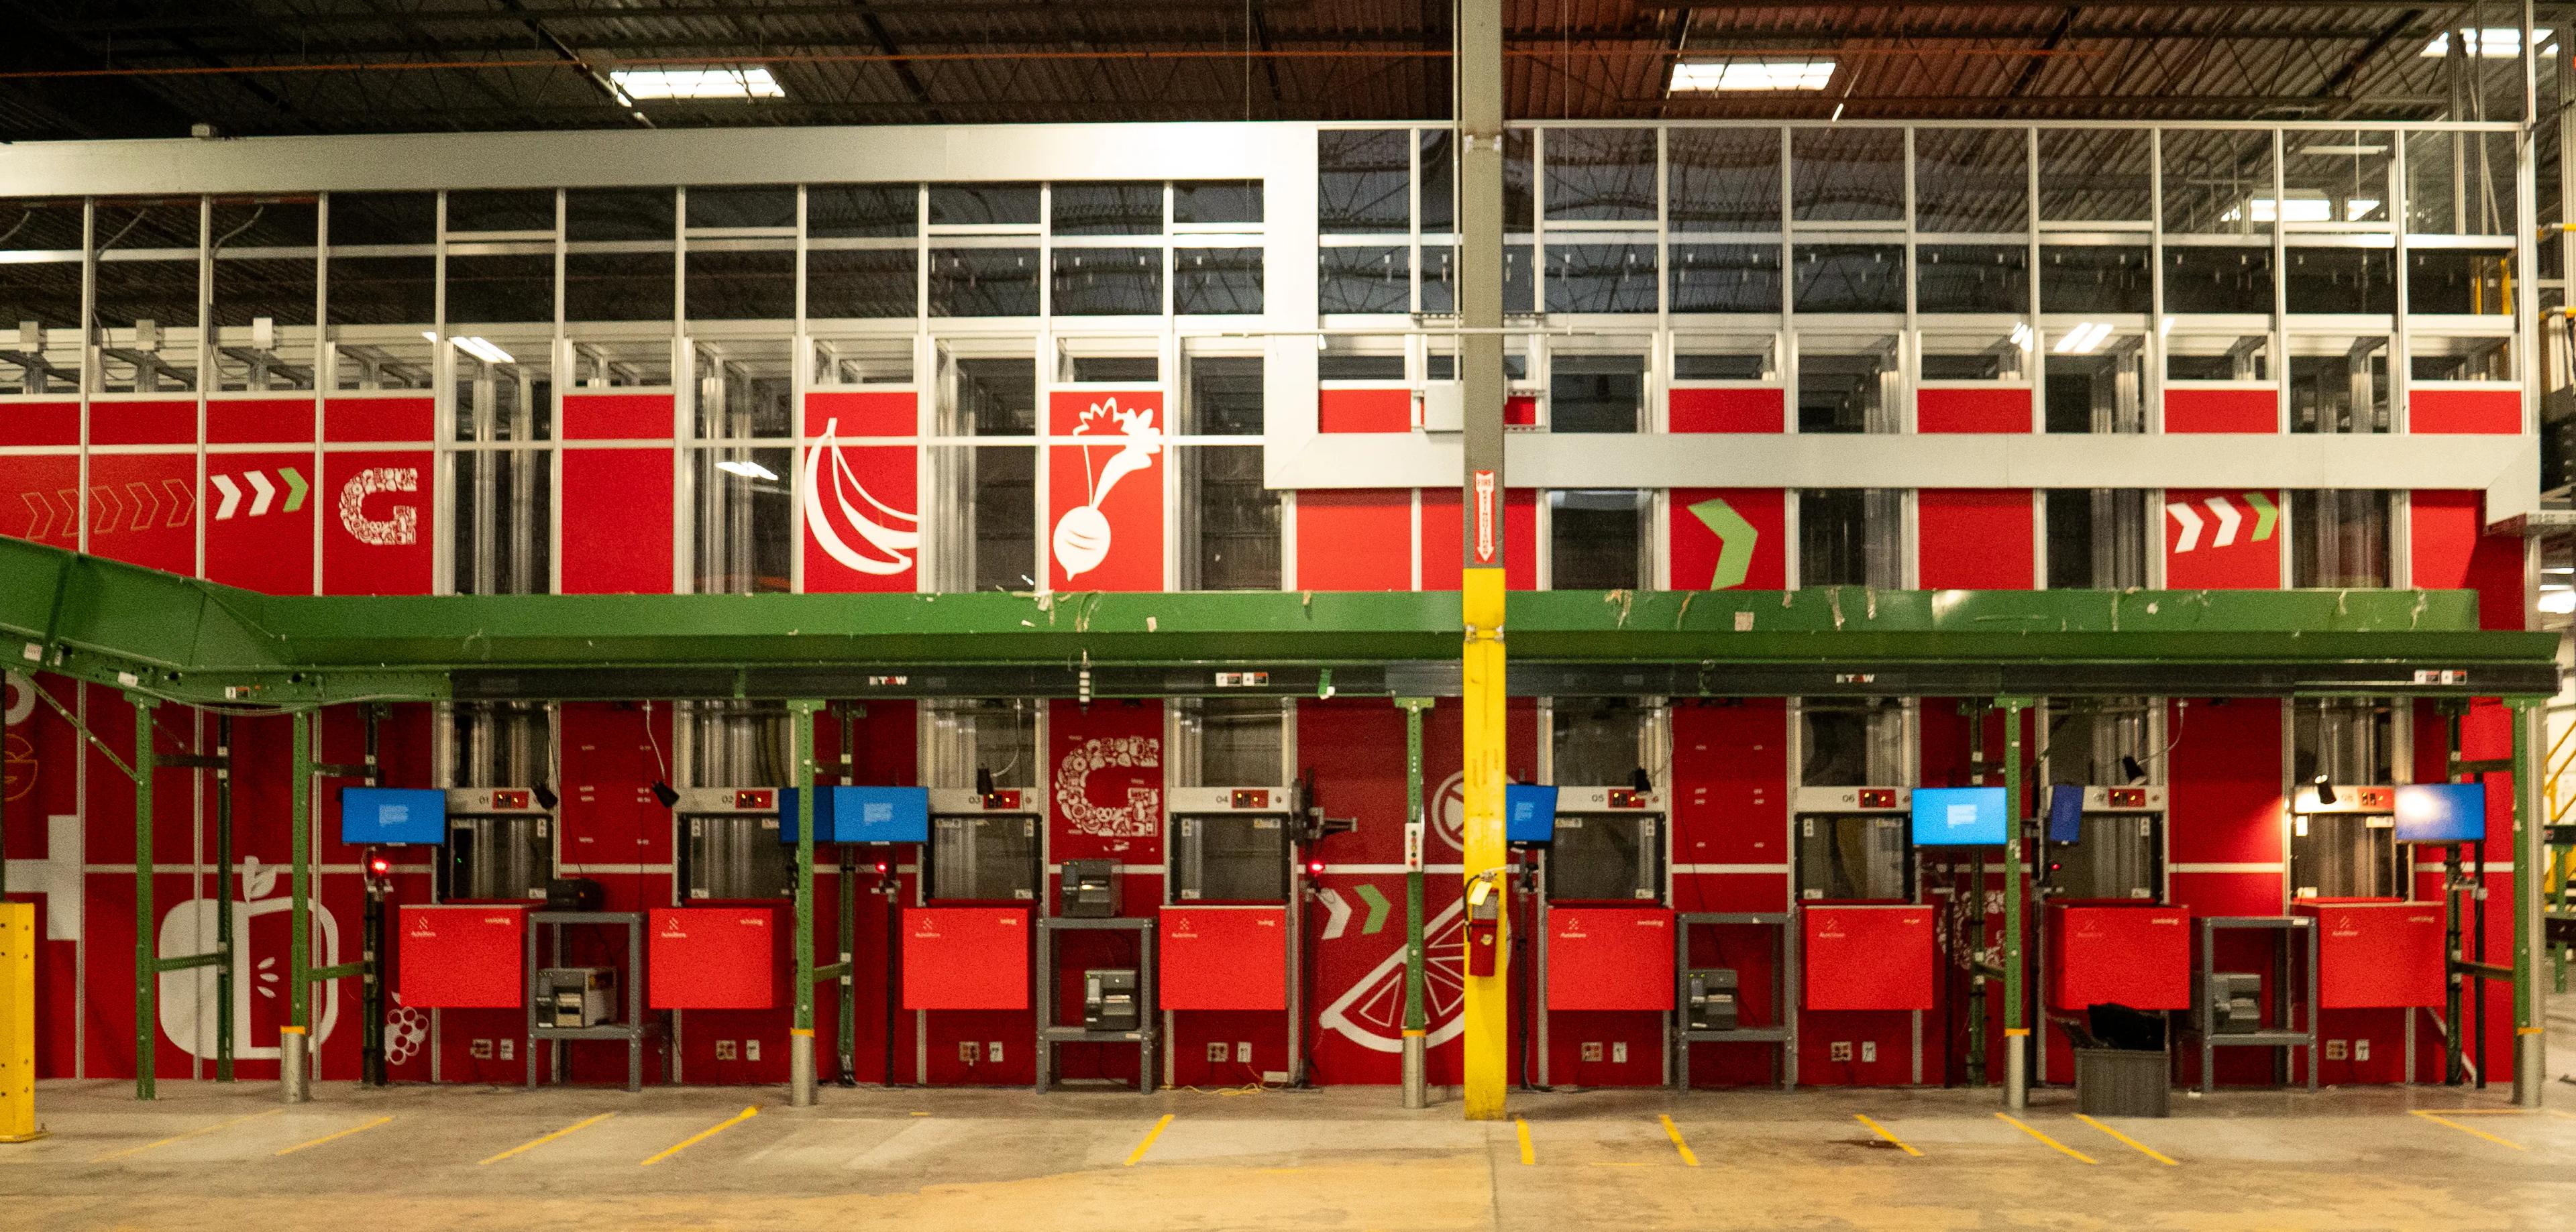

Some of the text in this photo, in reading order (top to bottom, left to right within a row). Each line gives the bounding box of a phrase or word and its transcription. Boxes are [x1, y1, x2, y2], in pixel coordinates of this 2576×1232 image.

[1477, 478, 1491, 487] FIRE
[478, 795, 490, 805] 01
[721, 795, 734, 804] 02
[968, 795, 981, 805] 03
[1216, 795, 1228, 803] 04
[1591, 794, 1604, 803] 05
[1842, 794, 1855, 803] 06
